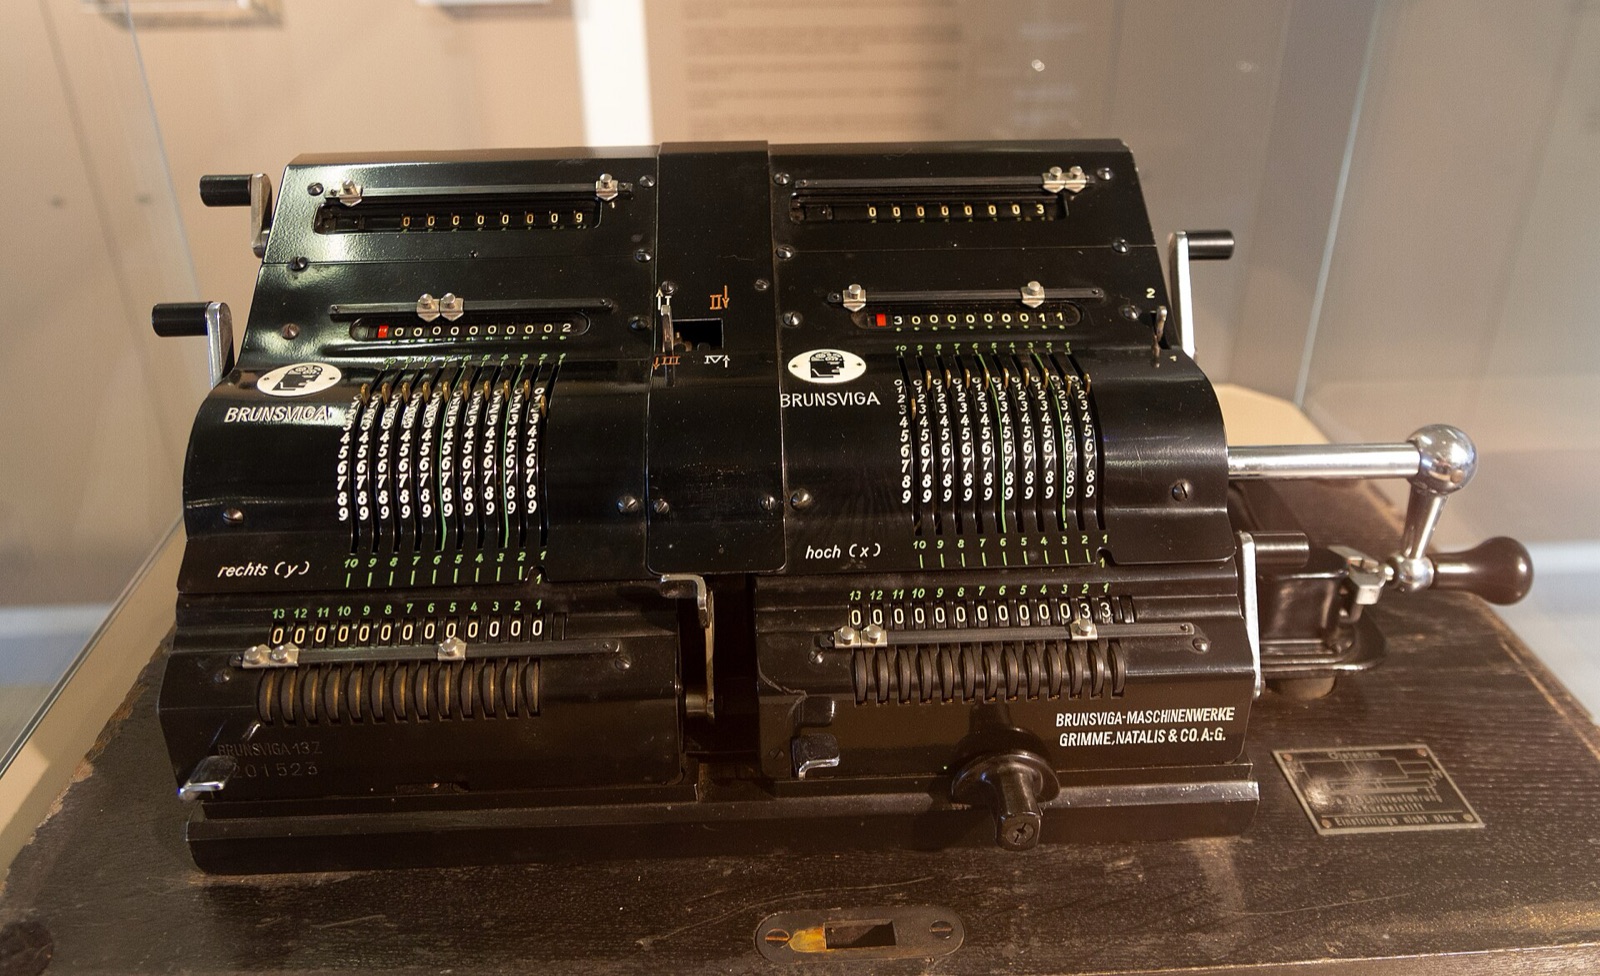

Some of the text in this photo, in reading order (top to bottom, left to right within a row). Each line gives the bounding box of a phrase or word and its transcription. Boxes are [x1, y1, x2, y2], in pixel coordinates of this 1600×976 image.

[1146, 288, 1155, 298] 2
[780, 391, 881, 408] BRUNSVIGA
[223, 405, 329, 423] BRUNSVIGA
[913, 534, 1108, 549] 10 9 8 7 6 5 4 3 2 1
[345, 551, 546, 568] 10 9 8 7 6 5 4 3 2 1
[805, 544, 841, 559] hoch
[217, 561, 268, 578] rechts
[850, 583, 1109, 601] 13 12 11 10 9 8 7 6 5 4 3 2 1
[273, 599, 542, 619] 13 12 11 10 9 8 7 6 5 4 3 2 1
[851, 602, 1111, 625] 0 0 0 0 0 0 0 0 0 0 0 3 3
[273, 620, 542, 644] 0 0 0 0 0 0 0 0 0 0 0 0 0
[1055, 707, 1236, 727] BRUNSVIGA-MASCHINENWERKE
[1167, 728, 1178, 743] &
